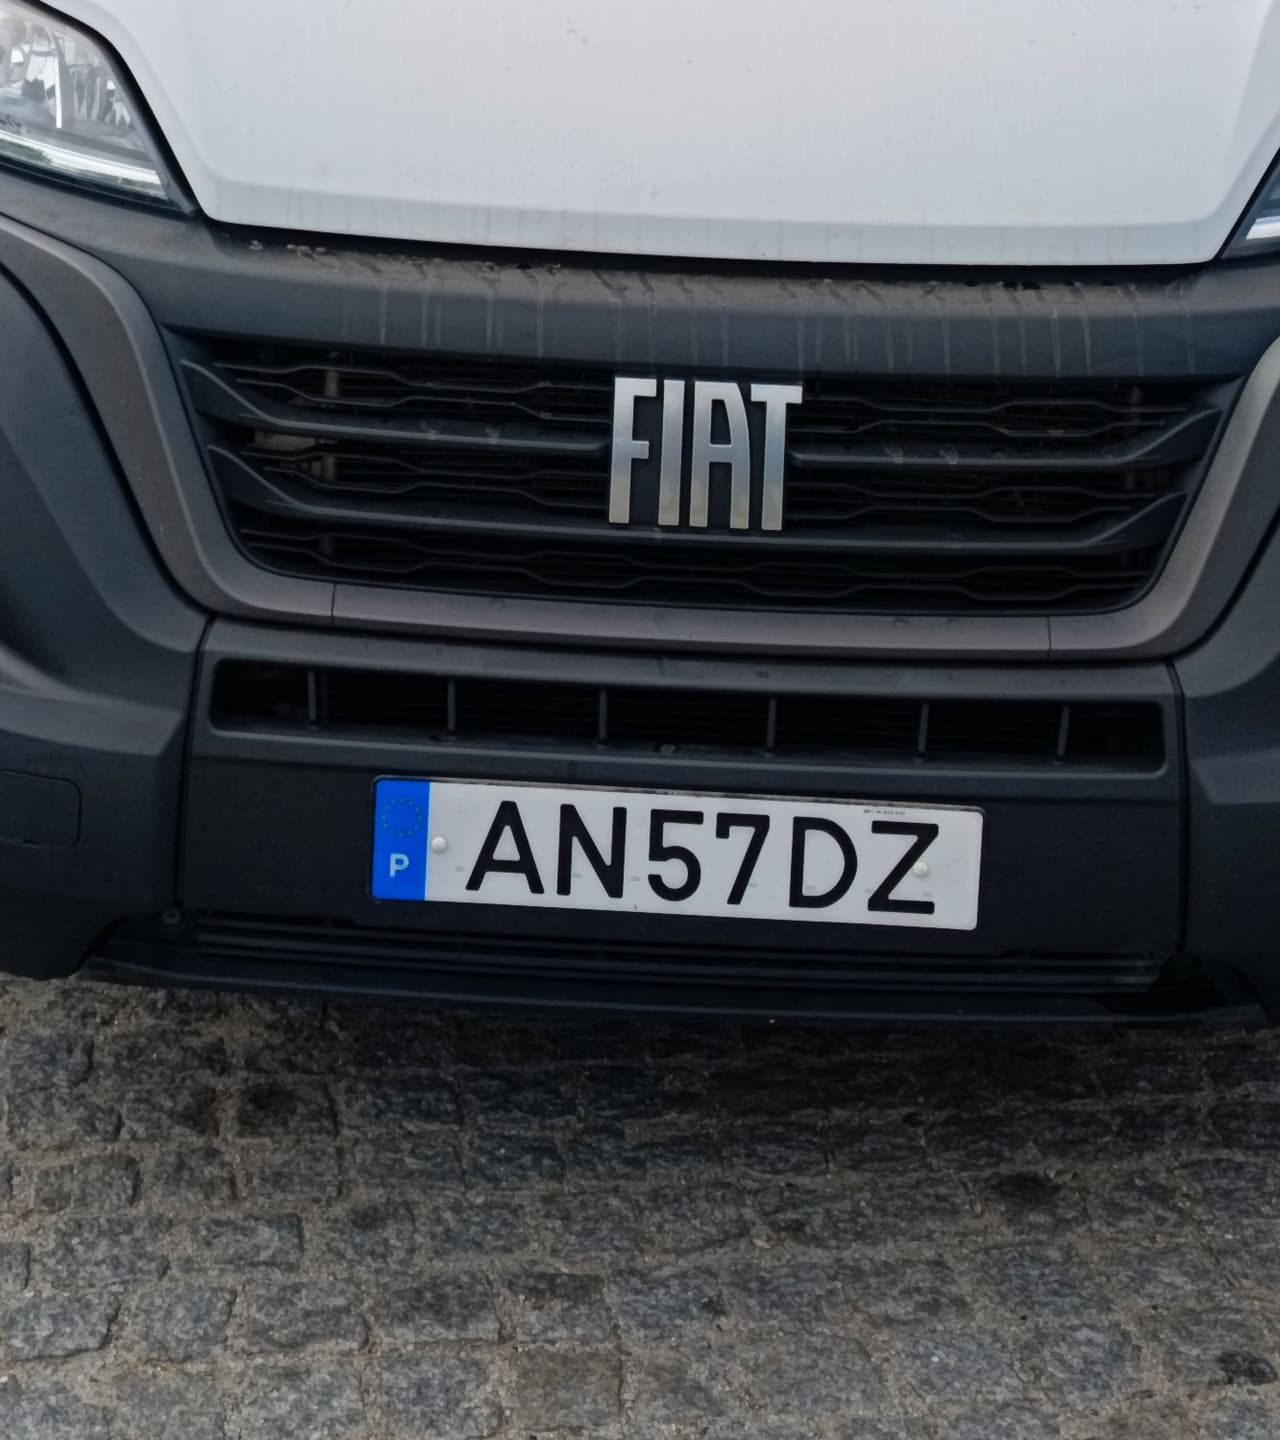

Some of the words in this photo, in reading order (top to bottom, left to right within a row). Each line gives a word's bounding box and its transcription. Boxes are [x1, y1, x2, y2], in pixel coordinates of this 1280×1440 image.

[608, 376, 803, 531] FIAT
[389, 852, 410, 878] P
[465, 800, 940, 914] AN57DZ
